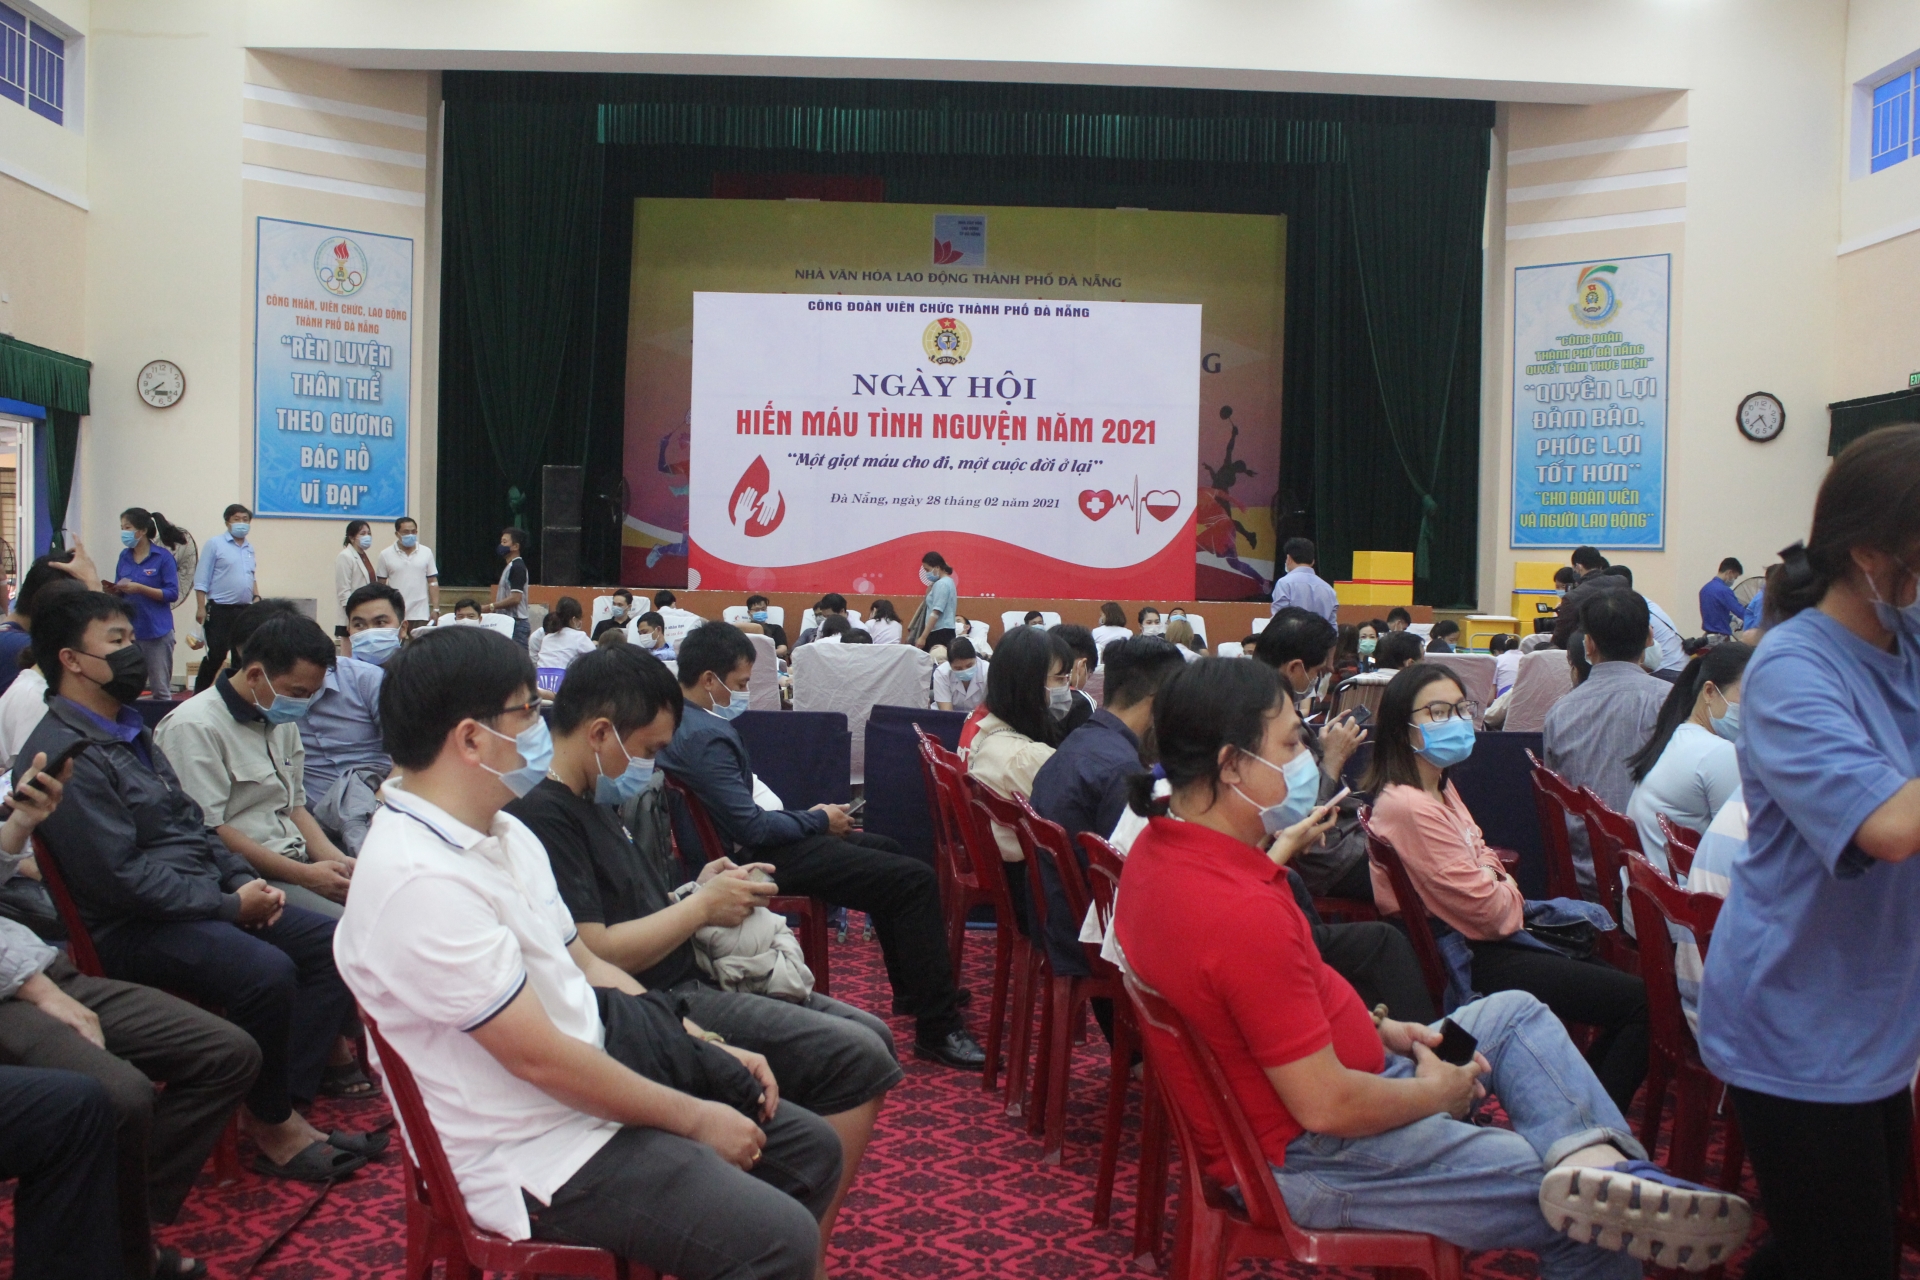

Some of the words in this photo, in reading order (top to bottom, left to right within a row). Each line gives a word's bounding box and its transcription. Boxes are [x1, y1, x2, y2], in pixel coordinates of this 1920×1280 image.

[795, 267, 825, 280] NHÀ
[829, 269, 857, 281] VĂN
[862, 269, 892, 282] HÓA
[897, 272, 924, 283] LAO
[928, 270, 968, 286] ĐỘNG
[972, 271, 1020, 285] THÀNH
[1025, 272, 1054, 286] PHỐ
[1058, 273, 1078, 287] ĐÀ
[1083, 273, 1122, 288] NẴNG
[266, 294, 289, 307] CÔNG
[320, 301, 338, 313] VIÊN
[368, 306, 383, 318] LAO
[386, 307, 407, 321] ĐỘNG
[808, 299, 842, 311] CÔNG
[847, 300, 882, 312] ĐOÀN
[886, 301, 915, 313] VIÊN
[919, 302, 954, 314] CHỨC
[958, 303, 999, 315] THÀNH
[1004, 303, 1030, 316] PHỐ
[1034, 304, 1051, 317] ĐÀ
[1055, 304, 1090, 318] NẴNG
[296, 315, 322, 328] THÀNH
[325, 316, 341, 330] PHỐ
[344, 319, 355, 332] ĐÀ
[335, 340, 392, 371] LUYỆN
[291, 370, 341, 398] THÂN
[346, 370, 382, 401] THỂ
[852, 367, 957, 397] NGÀY
[967, 370, 1037, 405] HỘI
[1617, 376, 1657, 399] LỢI
[276, 407, 324, 433] THEO
[330, 411, 393, 437] GƯƠNG
[736, 400, 792, 436] HIẾN
[802, 406, 858, 437] MÁU
[868, 407, 923, 438] TÌNH
[932, 410, 1027, 446] NGUYỆN
[1037, 412, 1093, 443] NĂM
[1102, 419, 1156, 445] 2021
[1532, 406, 1586, 429] ĐẢM
[301, 443, 339, 469] BÁC
[345, 442, 370, 471] HỒ
[1536, 434, 1597, 456] PHÚC
[1602, 434, 1641, 456] LỢI
[827, 453, 860, 470] giọt
[862, 453, 900, 468] máu
[902, 455, 930, 469] cho
[933, 455, 954, 470] đi,
[957, 457, 990, 474] một
[992, 458, 1028, 474] cuộc
[1030, 457, 1056, 472] đời
[1058, 458, 1070, 472] ở
[1536, 460, 1576, 483] TỐT
[300, 479, 321, 505] VĨ
[830, 492, 848, 503] Đà
[892, 494, 923, 507] ngày
[926, 495, 941, 505] 28
[944, 496, 981, 509] tháng
[984, 497, 999, 507] 02
[1002, 497, 1029, 508] năm
[1032, 498, 1060, 508] 2021
[1569, 488, 1605, 505] ĐOÀN
[1608, 488, 1639, 505] VIÊN
[1520, 512, 1537, 527] VÀ
[1540, 511, 1578, 528] NGƯỜI
[1581, 513, 1607, 528] LAO
